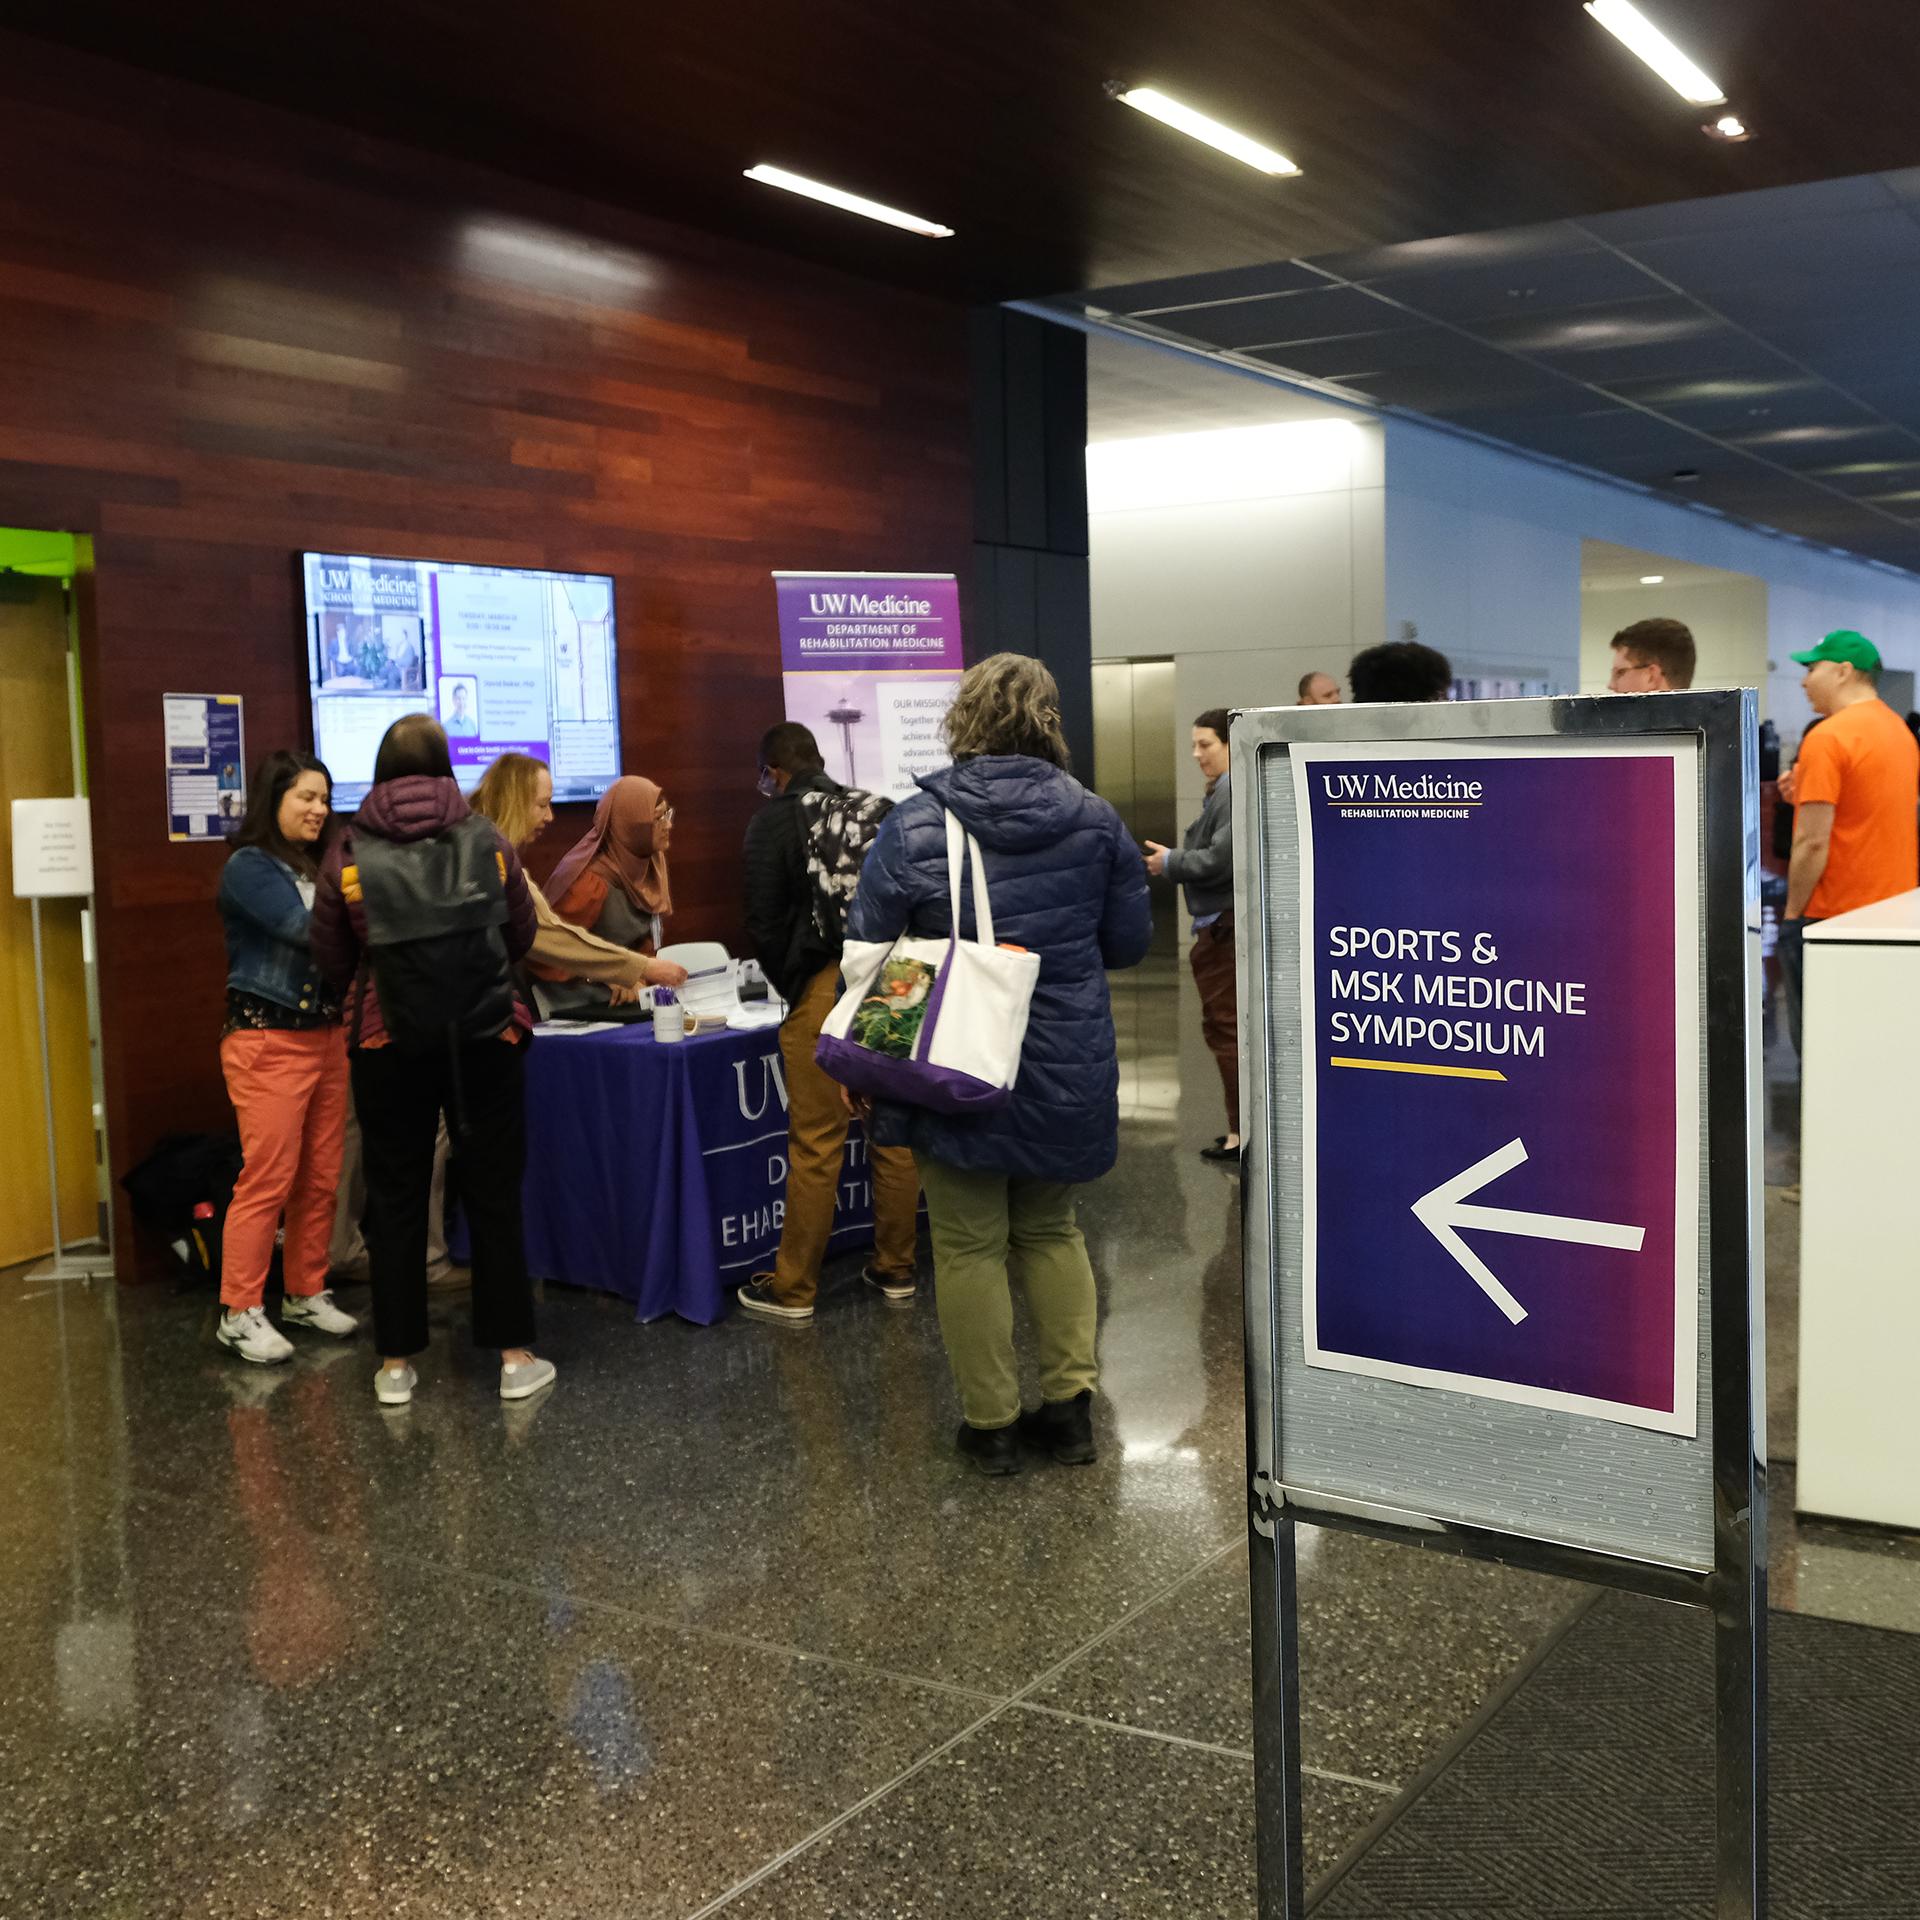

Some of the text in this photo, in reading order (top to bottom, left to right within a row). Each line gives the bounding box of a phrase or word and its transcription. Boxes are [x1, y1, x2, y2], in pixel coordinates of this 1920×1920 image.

[319, 568, 350, 589] UW
[809, 593, 932, 617] UW Medicine
[826, 623, 917, 636] DEPARTMENT OF
[799, 637, 945, 650] REHABILITATION MEDICINE
[893, 698, 912, 709] OUR
[901, 715, 934, 727] Together
[902, 731, 931, 741] achieve
[903, 748, 934, 758] advance
[1322, 774, 1483, 799] UW Medicine
[1341, 808, 1470, 819] REHABILITATION MEDICINE
[1329, 926, 1499, 965] SPORTS &
[1331, 969, 1587, 1016] MSK MEDICINE
[1330, 1011, 1545, 1058] SYMPOSIUM
